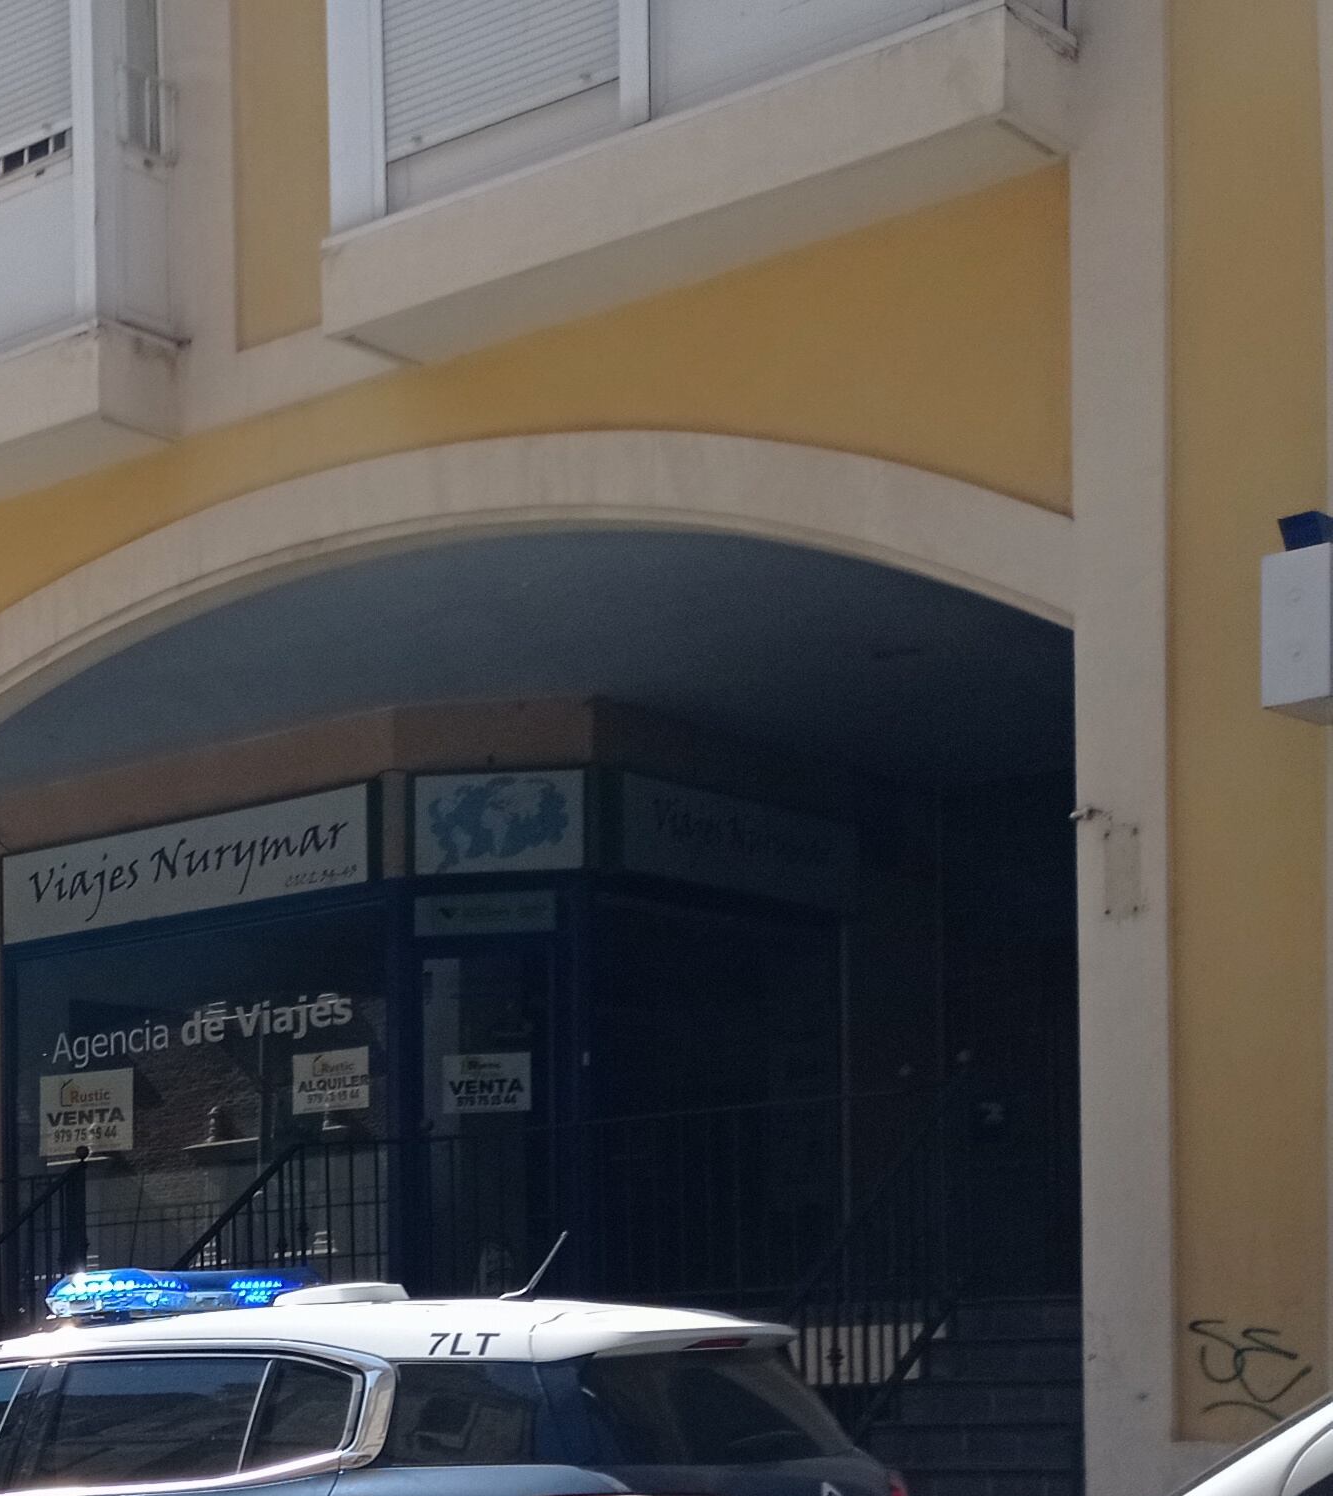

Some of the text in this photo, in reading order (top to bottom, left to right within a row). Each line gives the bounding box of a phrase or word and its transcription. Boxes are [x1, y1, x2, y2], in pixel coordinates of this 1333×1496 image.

[29, 821, 349, 922] Viajes Nurymar
[52, 995, 352, 1068] Agencia de Viajes
[298, 1074, 371, 1093] ALQUILER
[449, 1078, 523, 1095] VENTA
[70, 1088, 110, 1104] Rustic
[47, 1106, 125, 1127] VENTA
[53, 1128, 72, 1143] 979
[75, 1127, 87, 1141] 75
[104, 1125, 117, 1139] 44
[428, 1332, 501, 1357] 7LT
